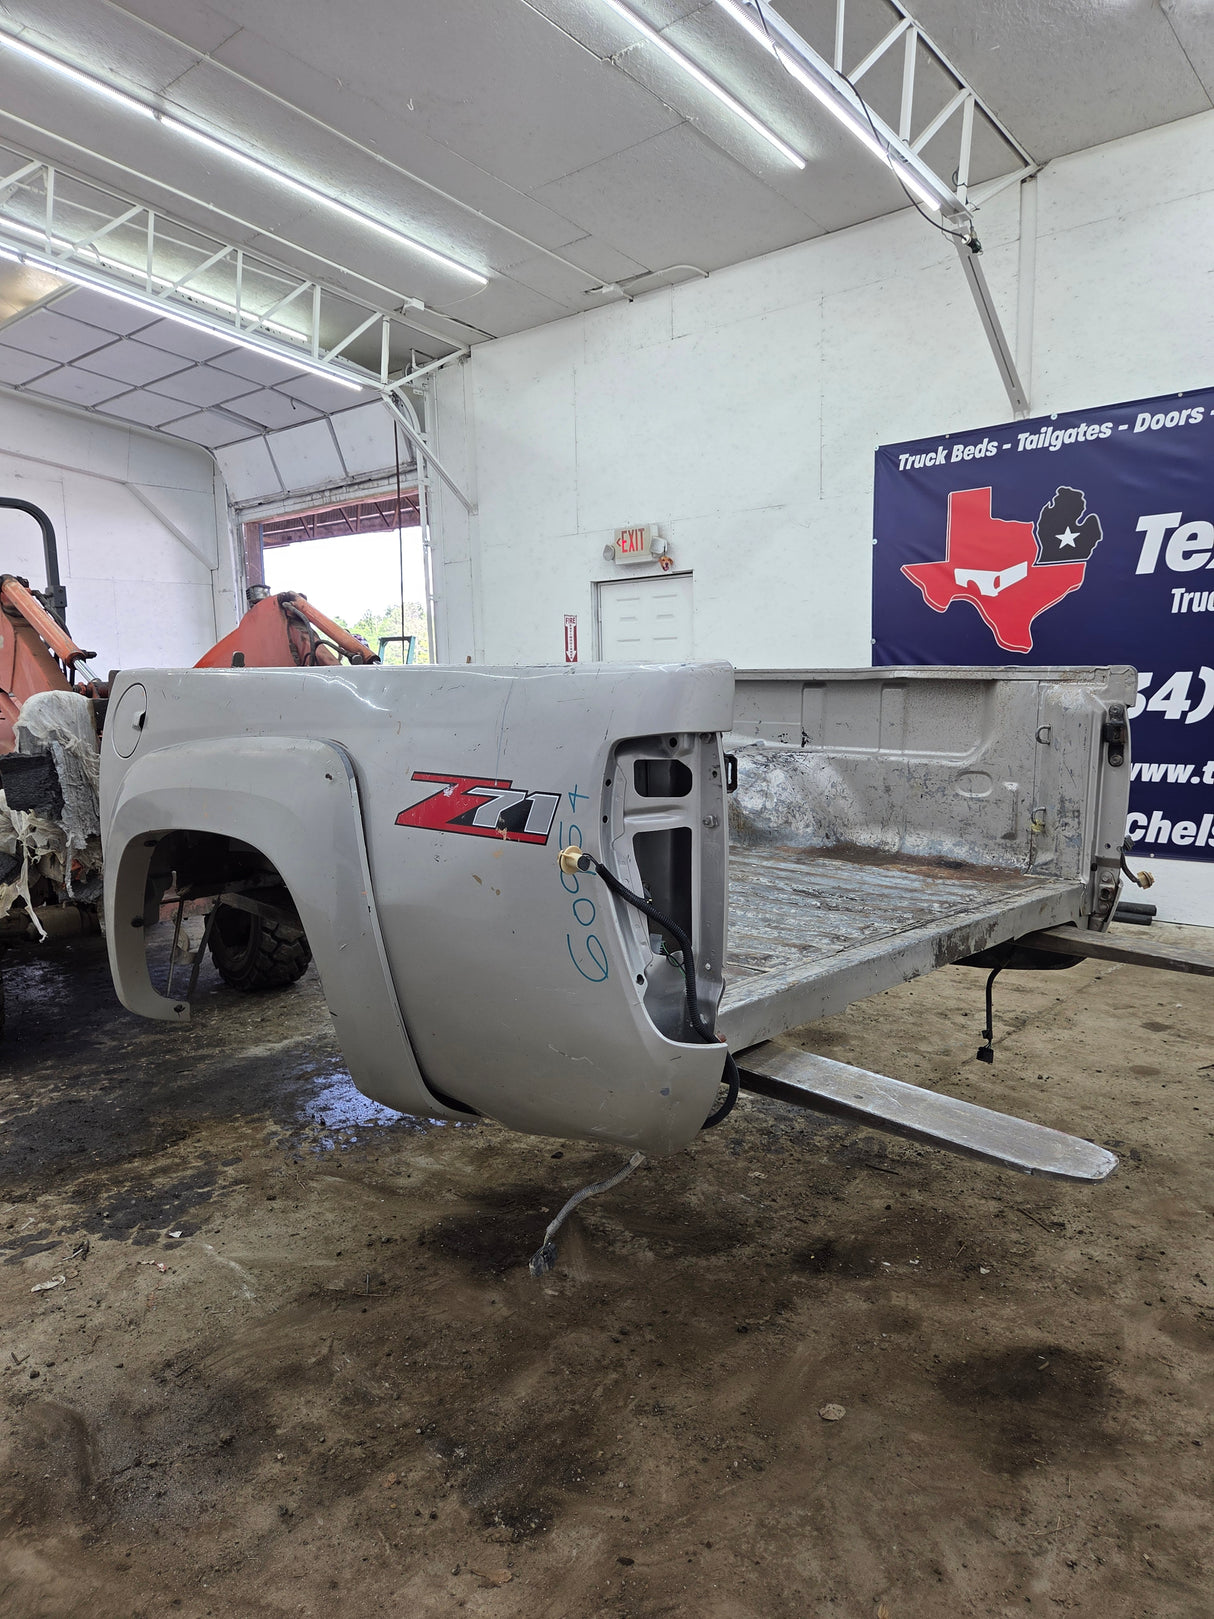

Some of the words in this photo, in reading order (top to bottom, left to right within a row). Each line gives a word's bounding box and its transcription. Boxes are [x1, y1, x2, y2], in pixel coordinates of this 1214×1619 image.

[899, 446, 947, 471] Truck
[951, 438, 998, 463] Beds
[1017, 421, 1113, 451] Tailgates
[1133, 406, 1205, 434] Doors
[621, 528, 645, 553] EXIT
[1135, 511, 1214, 575] Te
[394, 771, 562, 846] Z71
[1125, 810, 1214, 847] Chel
